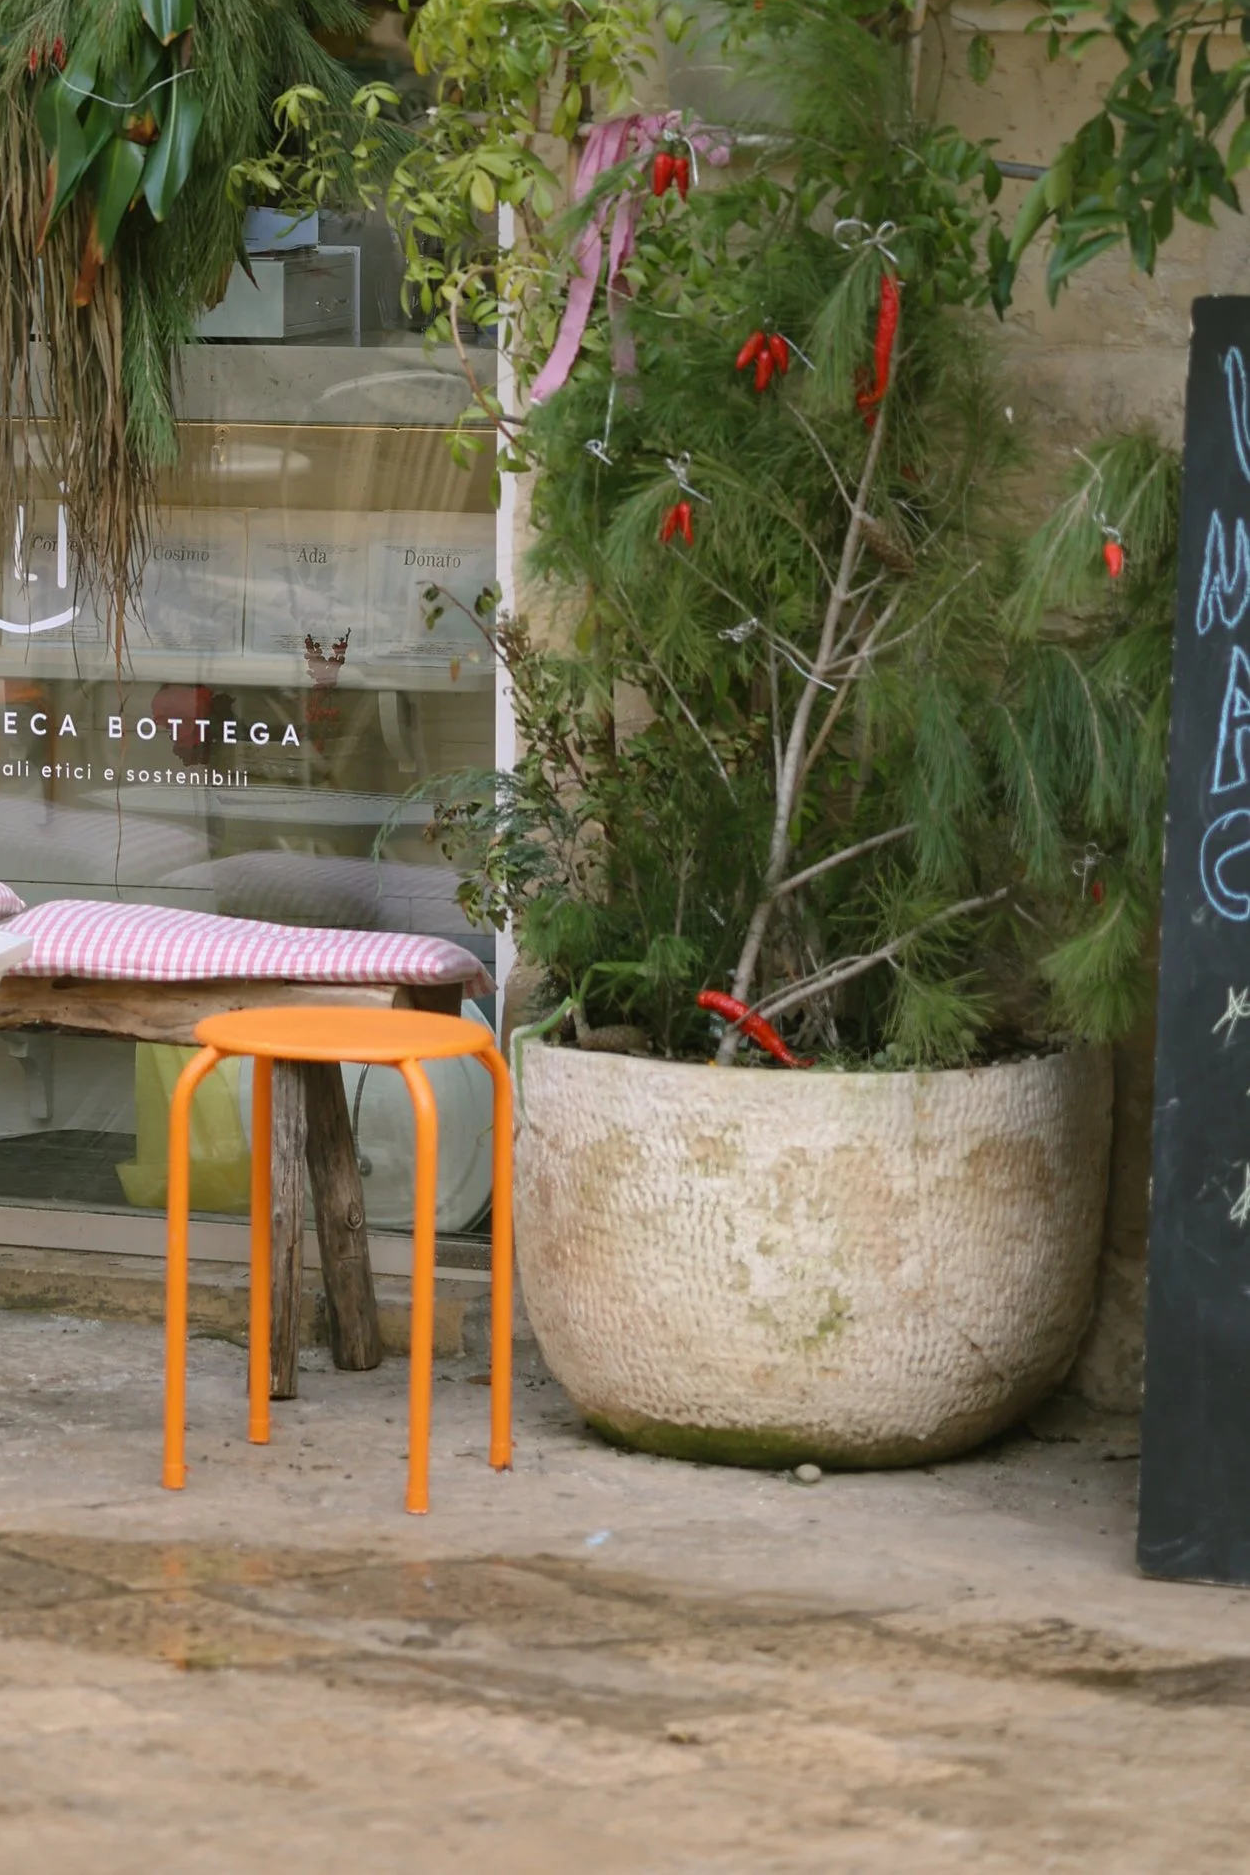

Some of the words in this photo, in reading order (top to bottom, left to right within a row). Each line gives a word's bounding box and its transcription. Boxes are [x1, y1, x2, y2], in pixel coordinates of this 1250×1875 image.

[153, 544, 210, 562] Cosimo
[296, 547, 328, 565] Ada
[403, 549, 462, 569] Donato
[108, 716, 300, 747] BOTTEGA
[41, 762, 92, 780] etici
[103, 767, 115, 781] e
[126, 768, 249, 787] sostenibili
